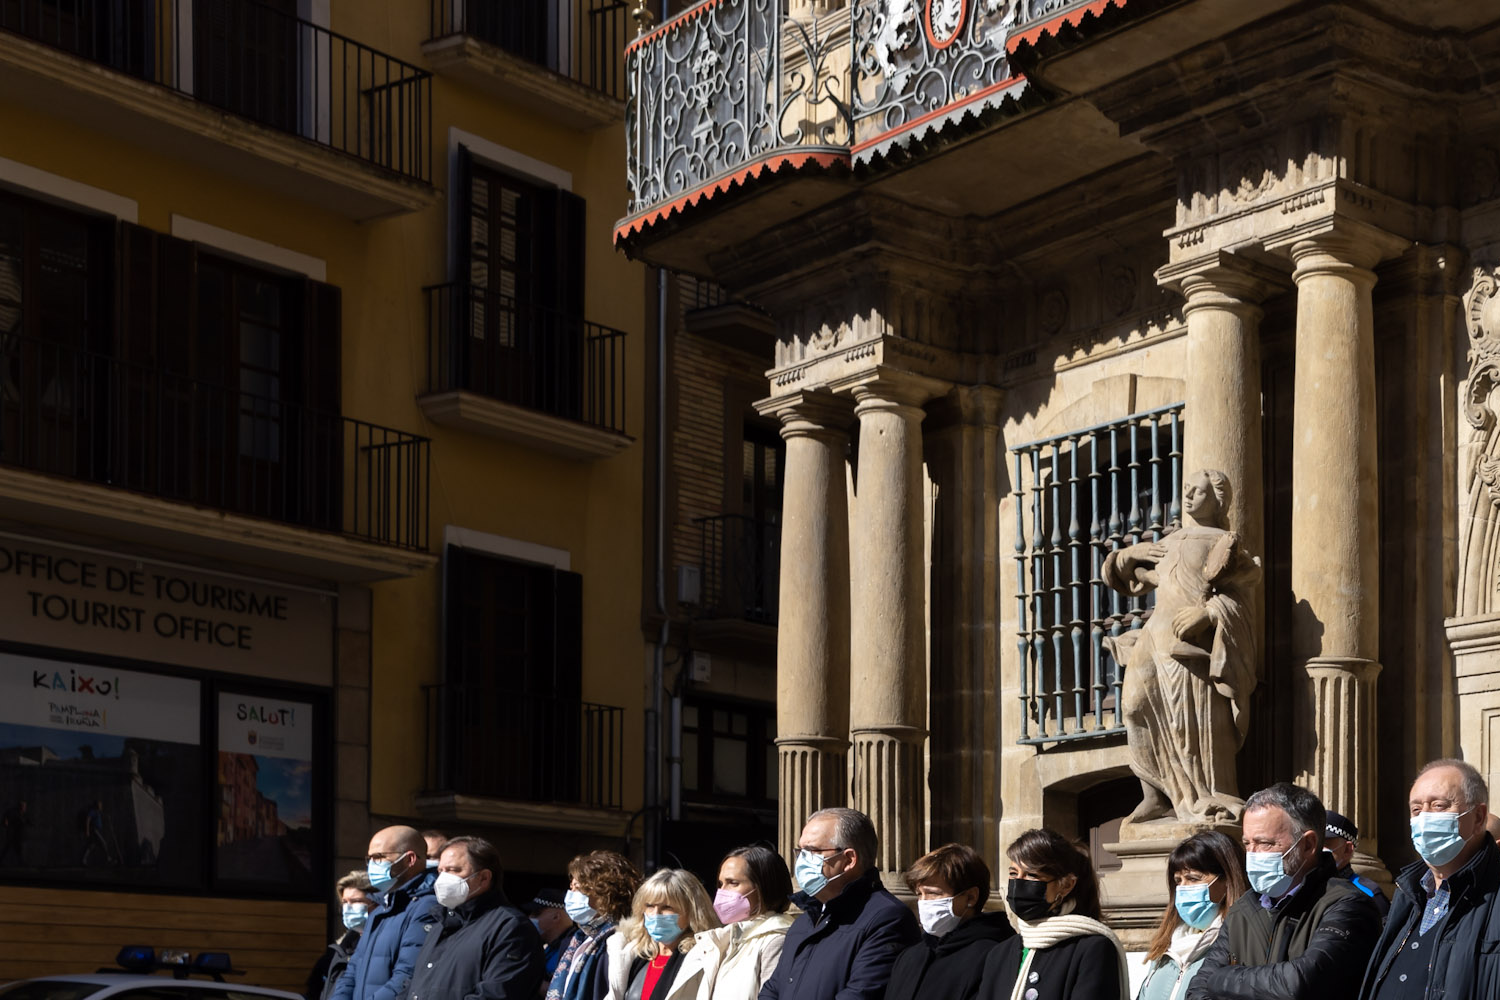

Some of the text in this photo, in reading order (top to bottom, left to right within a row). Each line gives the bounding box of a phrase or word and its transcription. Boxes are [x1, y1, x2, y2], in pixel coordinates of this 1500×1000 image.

[27, 591, 253, 650] TOURIST OFFICE
[106, 567, 145, 596] DE
[152, 575, 289, 620] TOURISME
